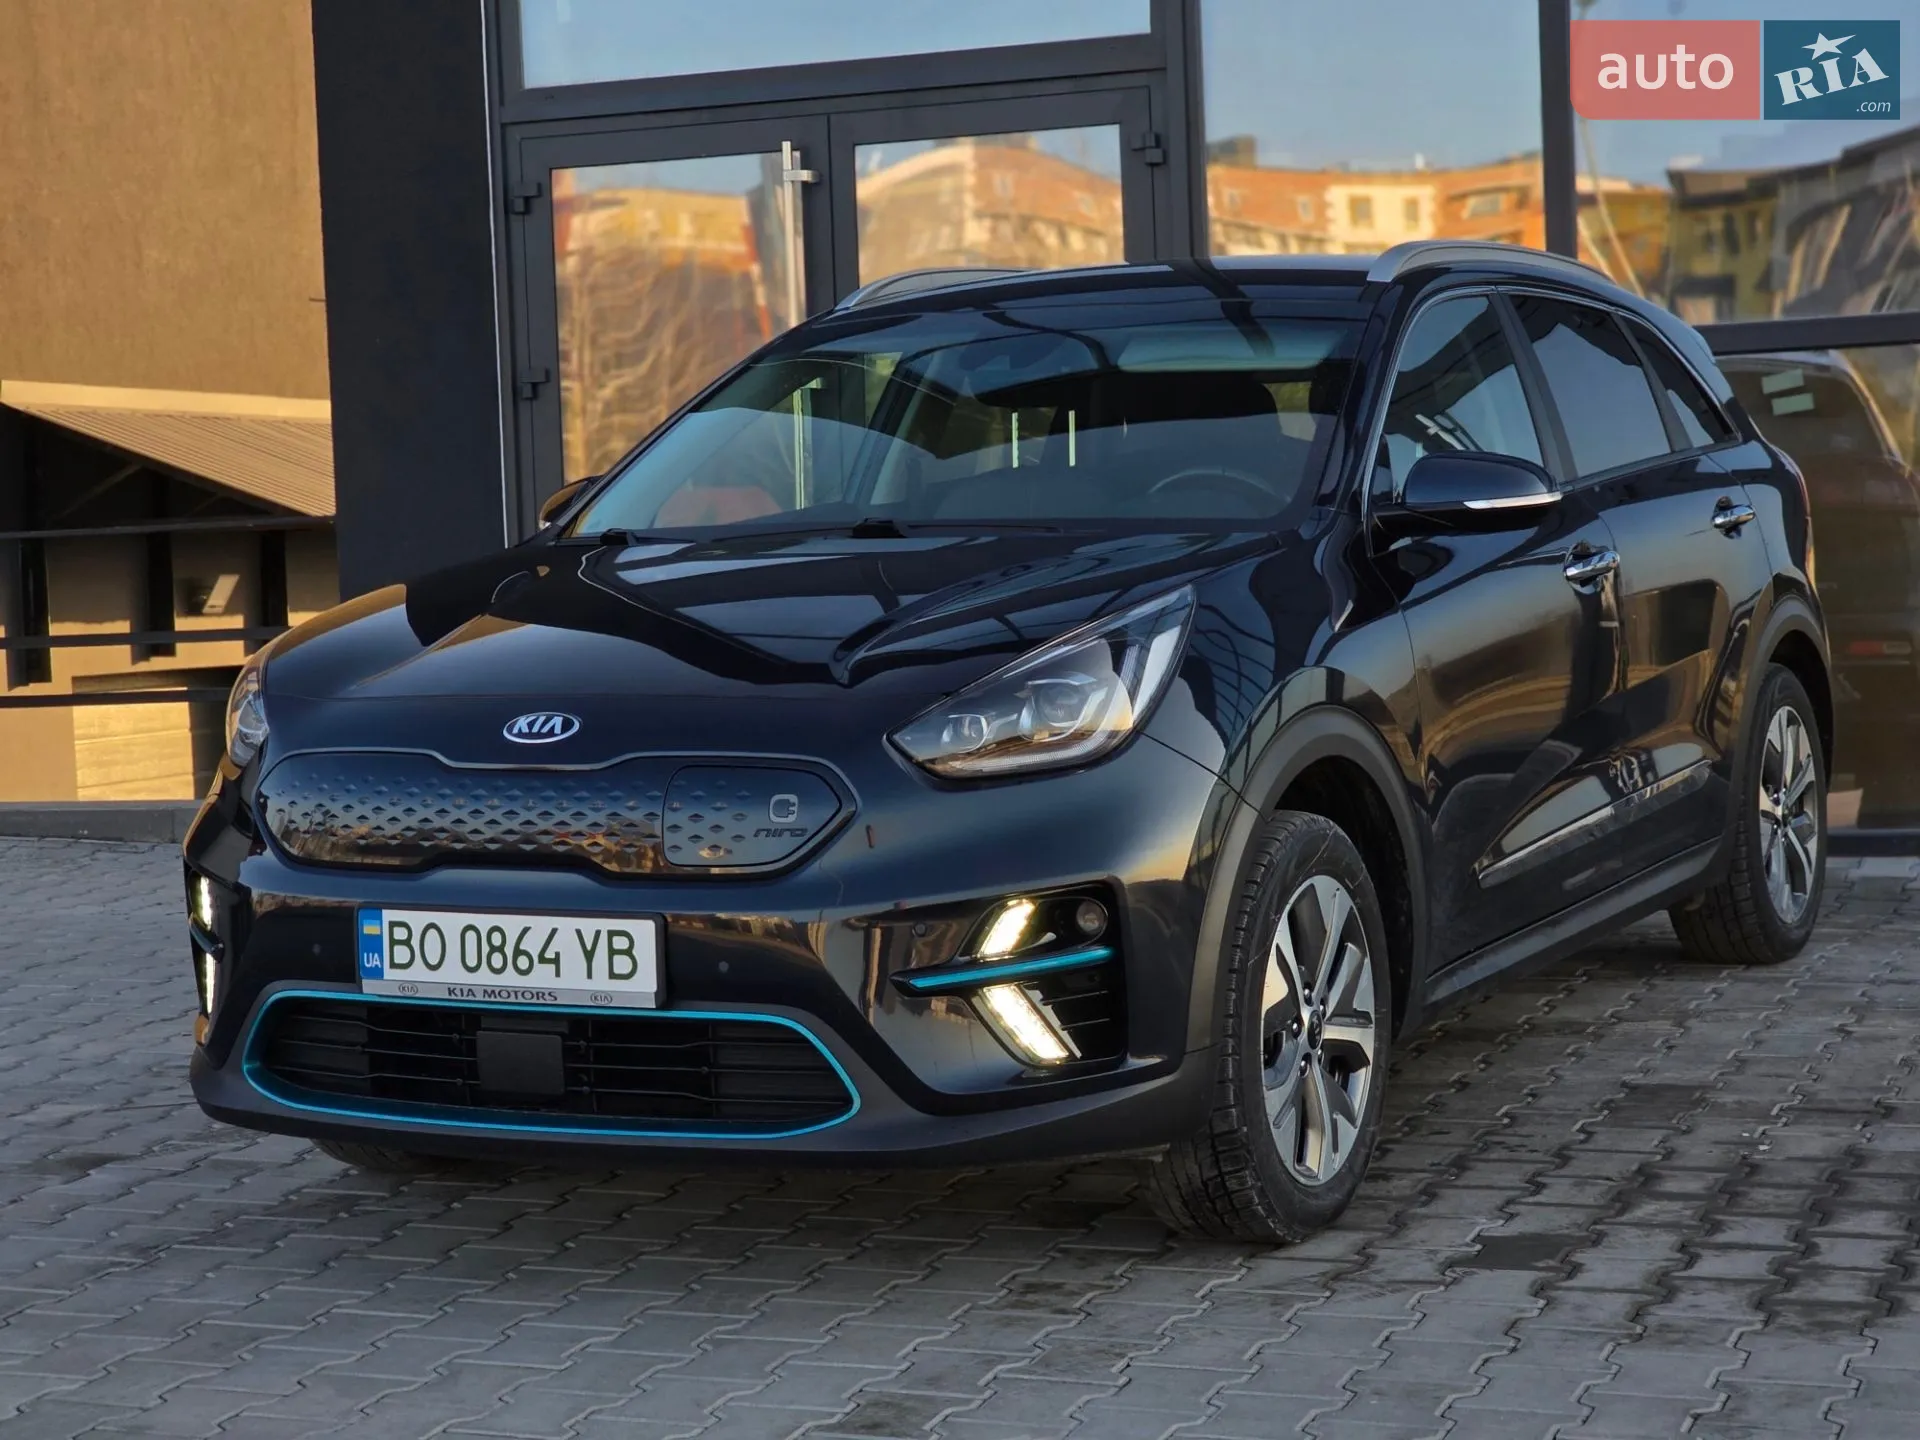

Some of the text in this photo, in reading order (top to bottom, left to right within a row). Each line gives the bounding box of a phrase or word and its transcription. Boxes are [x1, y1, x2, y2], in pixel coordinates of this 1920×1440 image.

[512, 715, 563, 734] KIA
[388, 920, 638, 980] BO 0864 YB
[363, 952, 382, 968] UA
[447, 987, 558, 1002] KIA MOTORS
